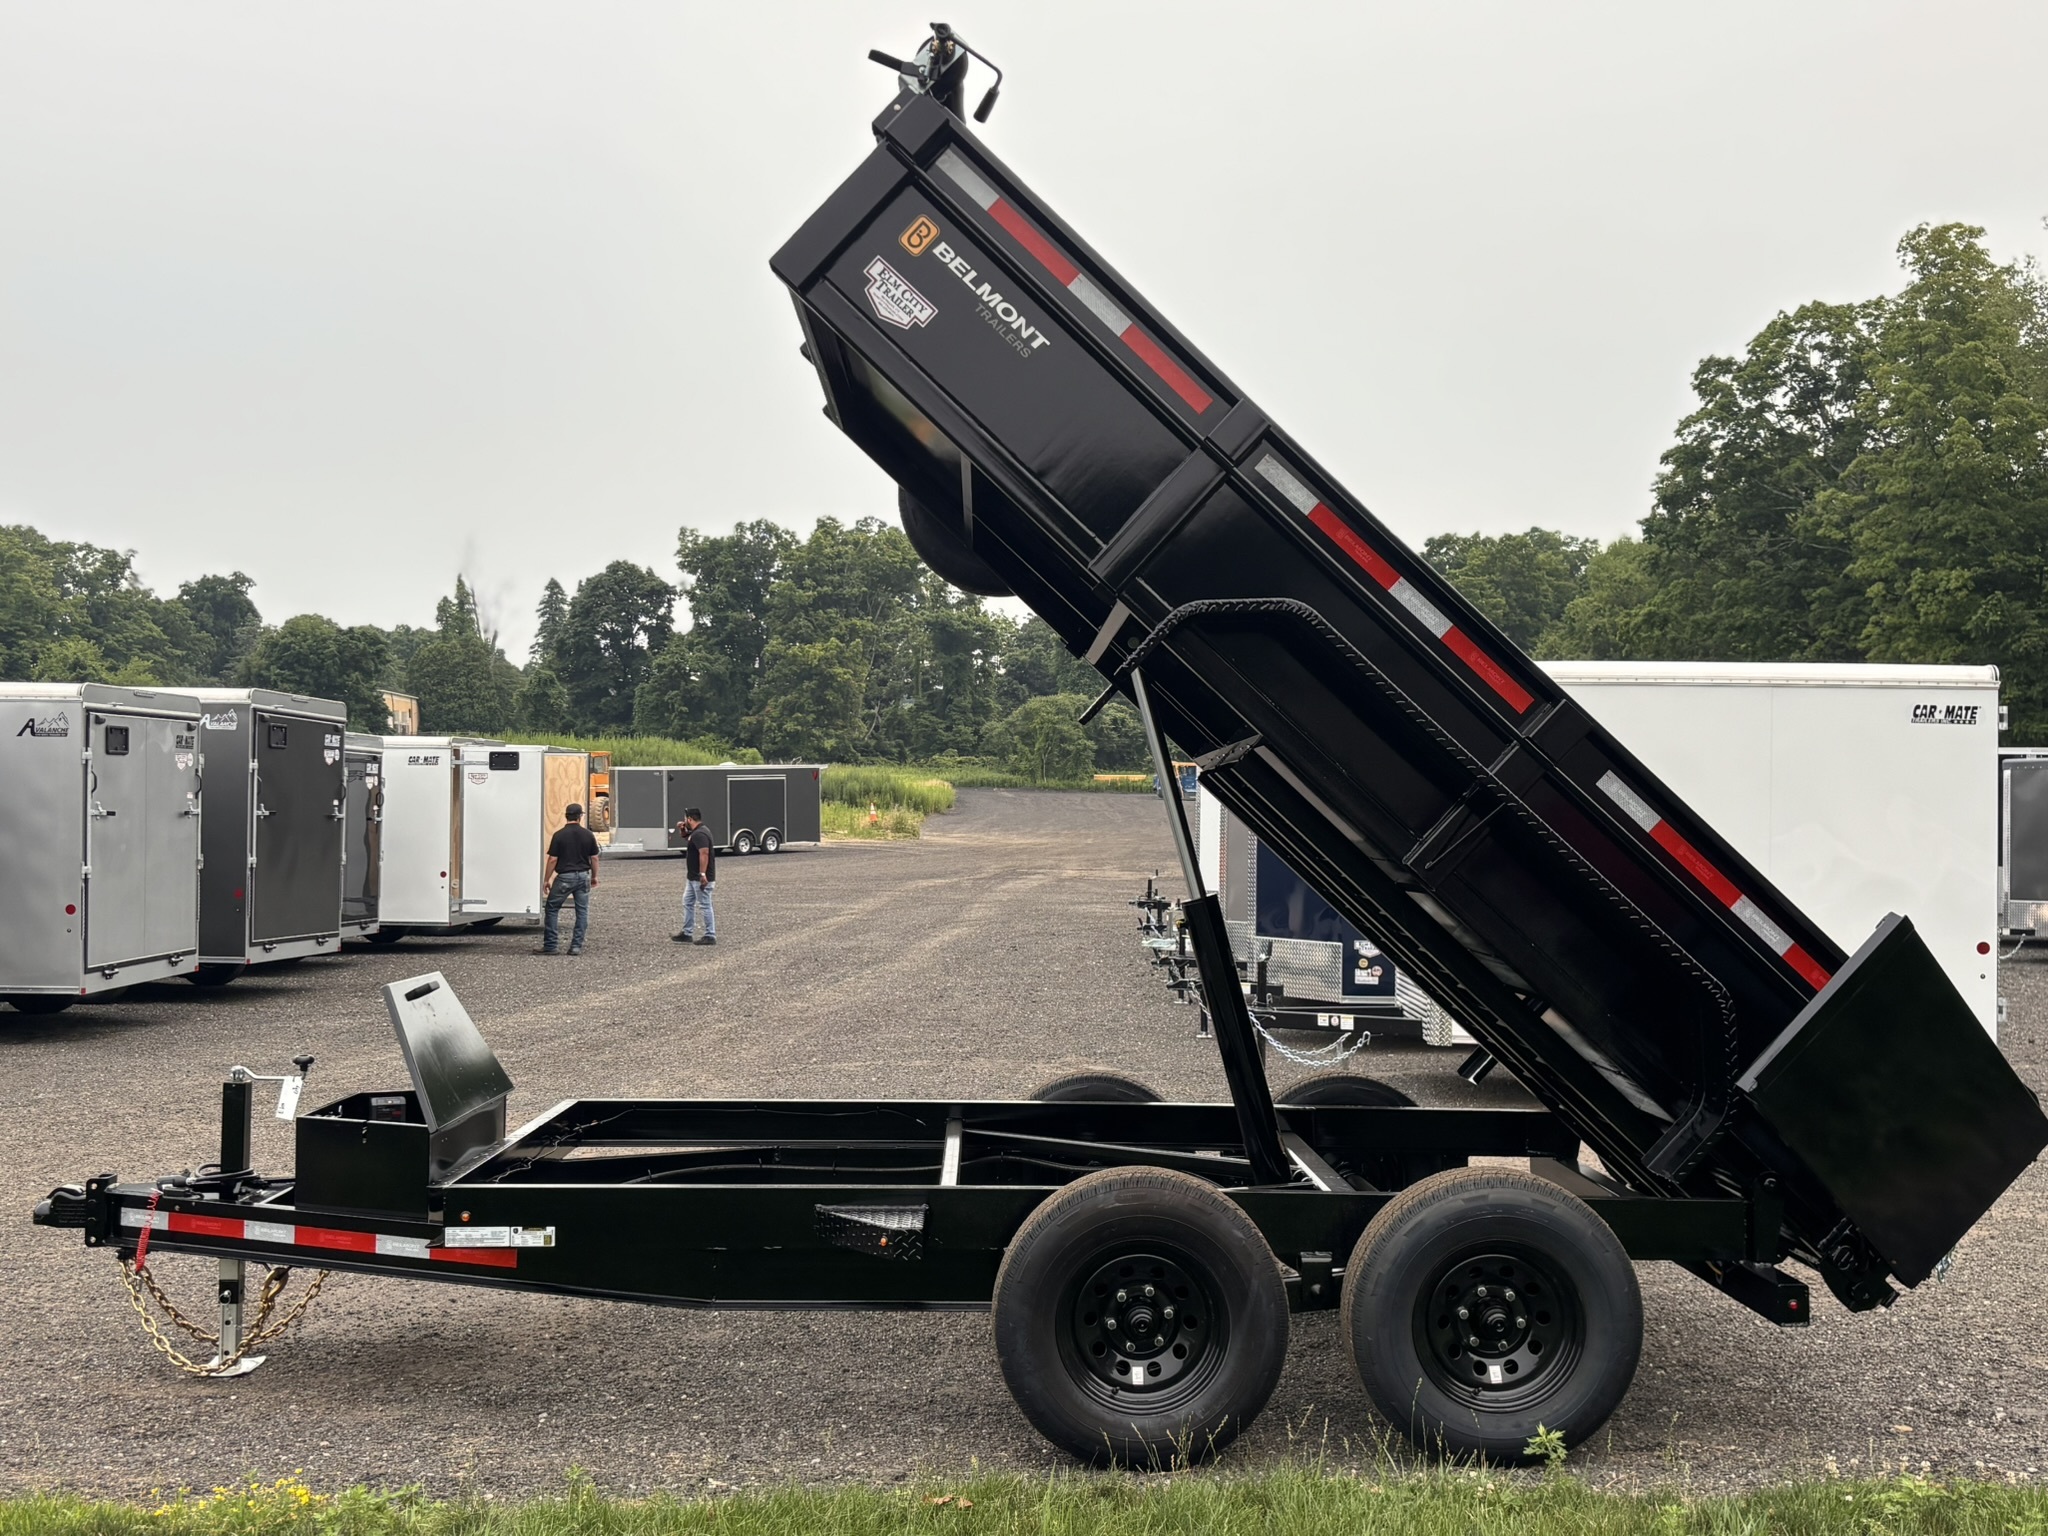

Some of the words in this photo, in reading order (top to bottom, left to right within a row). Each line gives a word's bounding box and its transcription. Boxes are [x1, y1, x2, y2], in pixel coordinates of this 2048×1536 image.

[876, 280, 914, 318] TRAILER
[877, 266, 902, 291] ELM
[901, 289, 928, 313] CITY
[932, 241, 1051, 350] BELMONT
[975, 303, 1031, 358] TRAILERS
